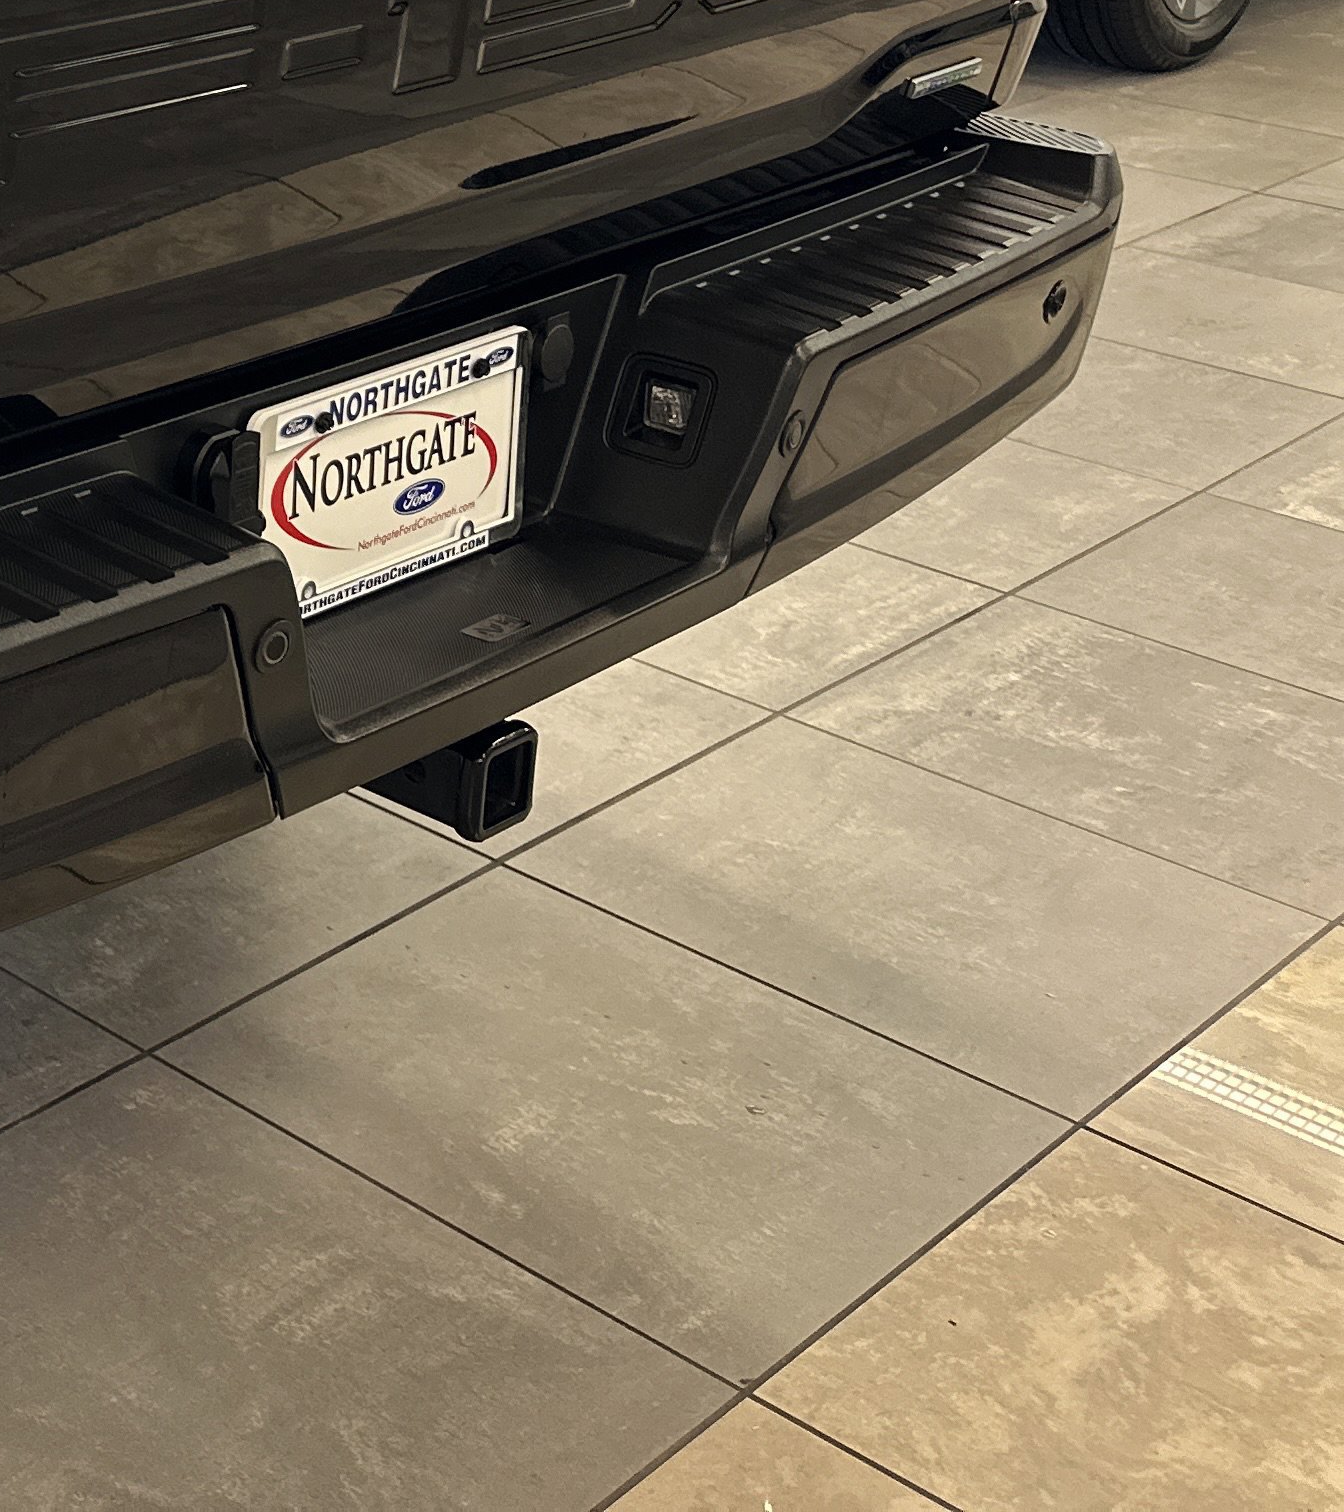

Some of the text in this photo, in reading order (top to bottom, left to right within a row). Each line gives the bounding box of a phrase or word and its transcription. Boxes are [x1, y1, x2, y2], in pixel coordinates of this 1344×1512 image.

[329, 353, 472, 426] NORTHGATE
[402, 484, 436, 510] Ford
[357, 500, 476, 552] NorthgateFordCincinnati.com
